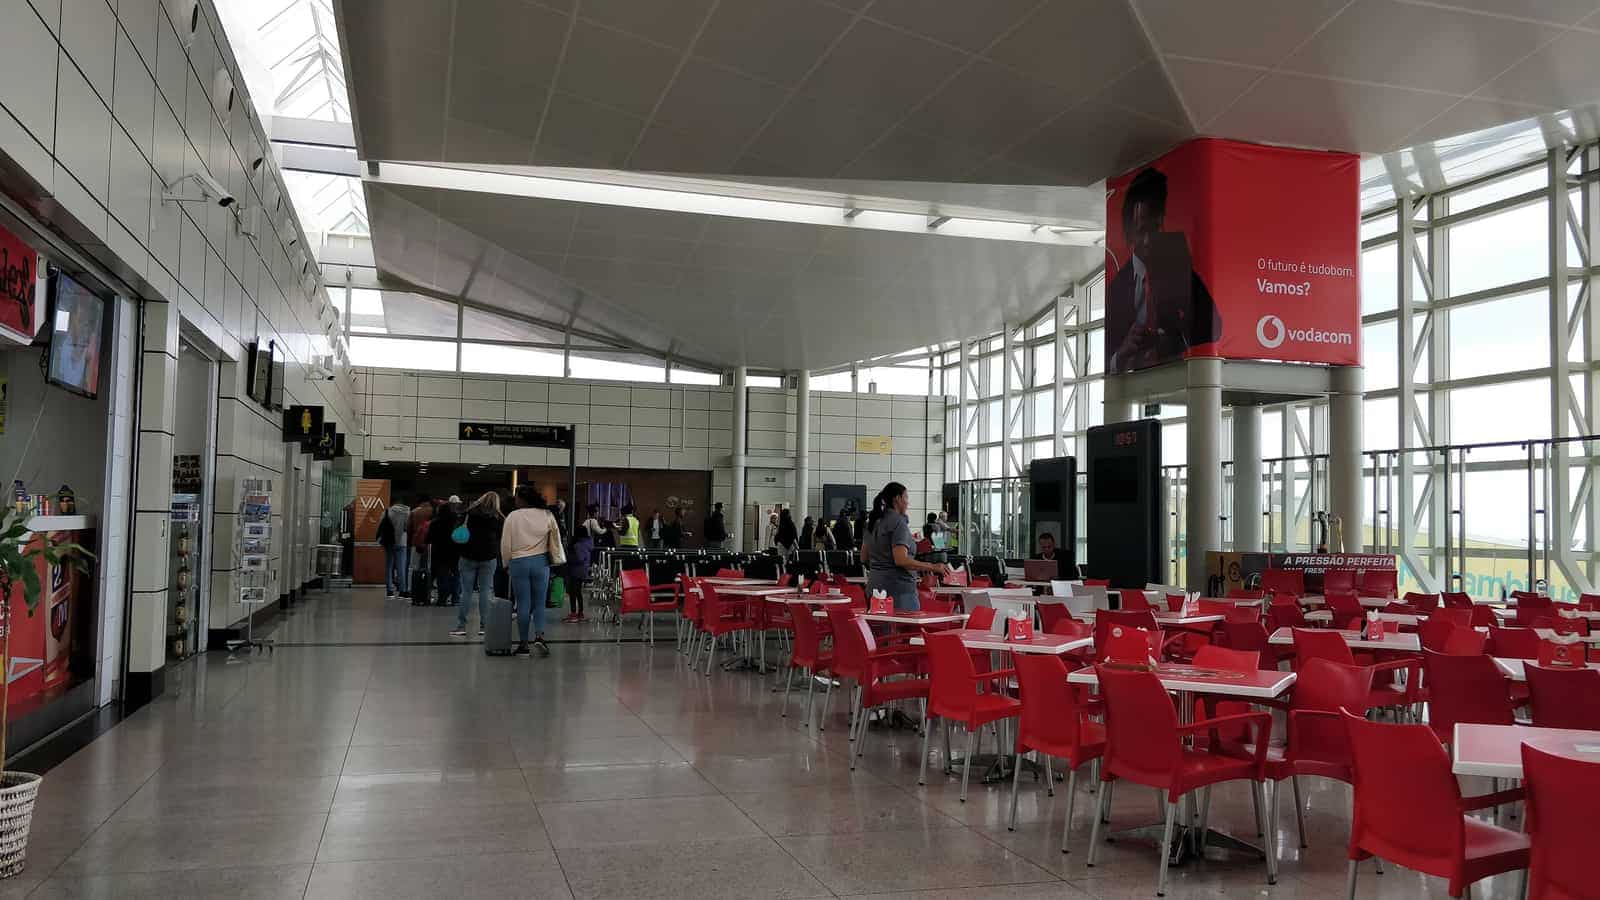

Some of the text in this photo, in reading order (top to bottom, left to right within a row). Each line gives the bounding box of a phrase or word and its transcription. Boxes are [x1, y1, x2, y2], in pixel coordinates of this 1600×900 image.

[1257, 258, 1266, 269] O
[1268, 259, 1298, 273] futuro
[1300, 262, 1307, 273] é
[1257, 278, 1311, 296] Vamos?
[1287, 328, 1352, 345] vodacom
[1284, 557, 1292, 565] A
[1346, 557, 1395, 567] PERFEITA
